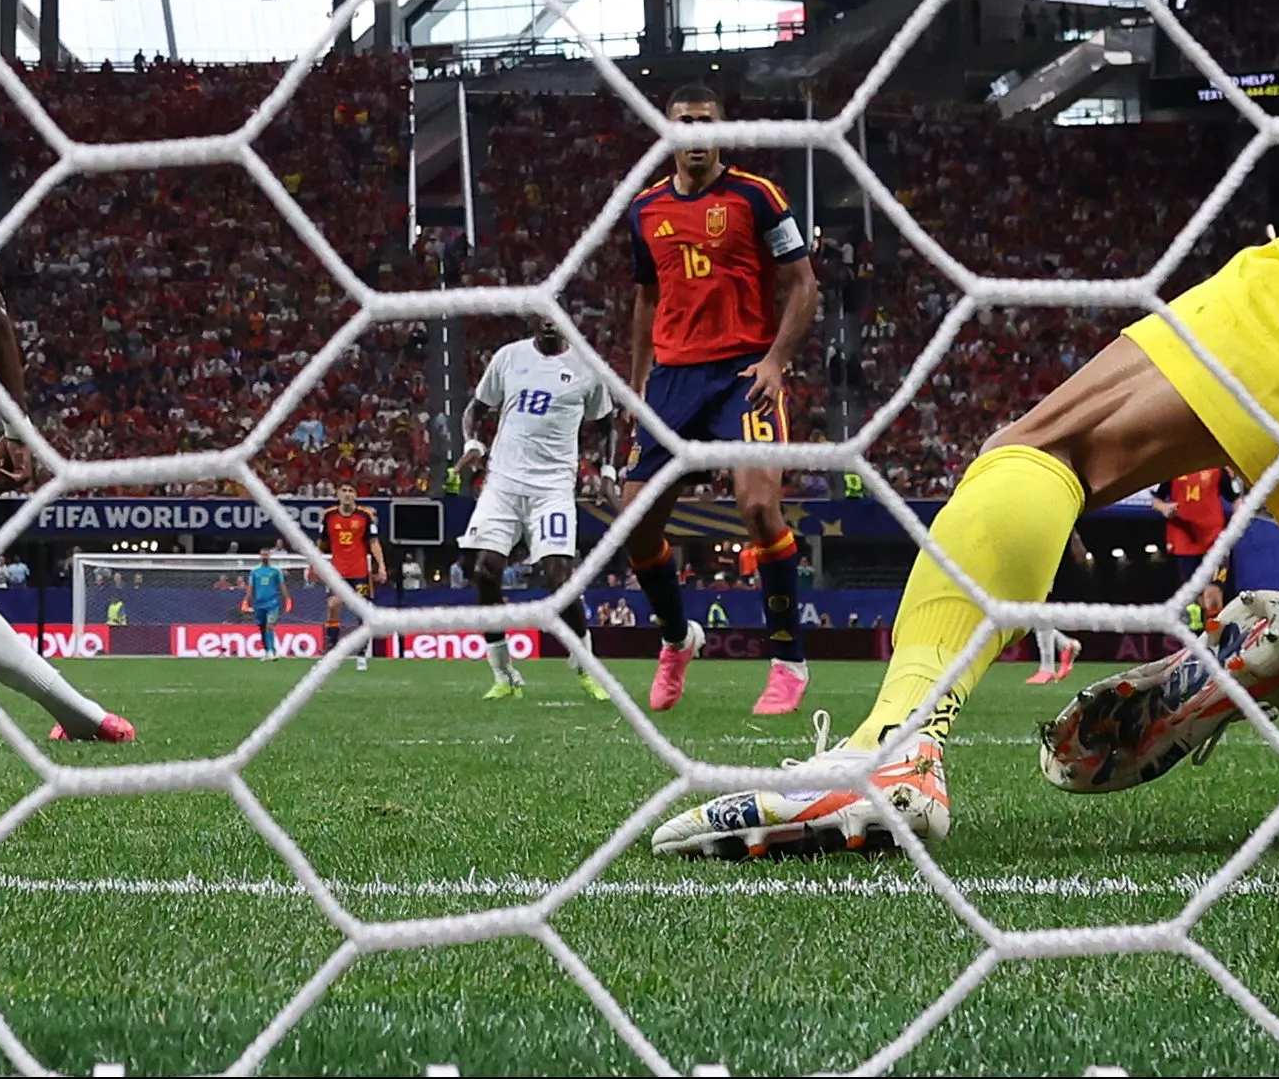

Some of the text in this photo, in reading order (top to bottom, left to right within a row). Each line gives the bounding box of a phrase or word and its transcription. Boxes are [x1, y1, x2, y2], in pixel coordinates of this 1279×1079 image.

[679, 242, 712, 279] 16
[741, 409, 774, 444] 16
[1186, 484, 1201, 502] 14
[39, 505, 104, 530] FIFA
[106, 506, 210, 529] WORLD
[214, 506, 274, 528] CUP
[539, 512, 568, 541] 10
[338, 531, 354, 546] 22
[392, 630, 533, 659] Lenoo
[703, 633, 761, 658] PCs
